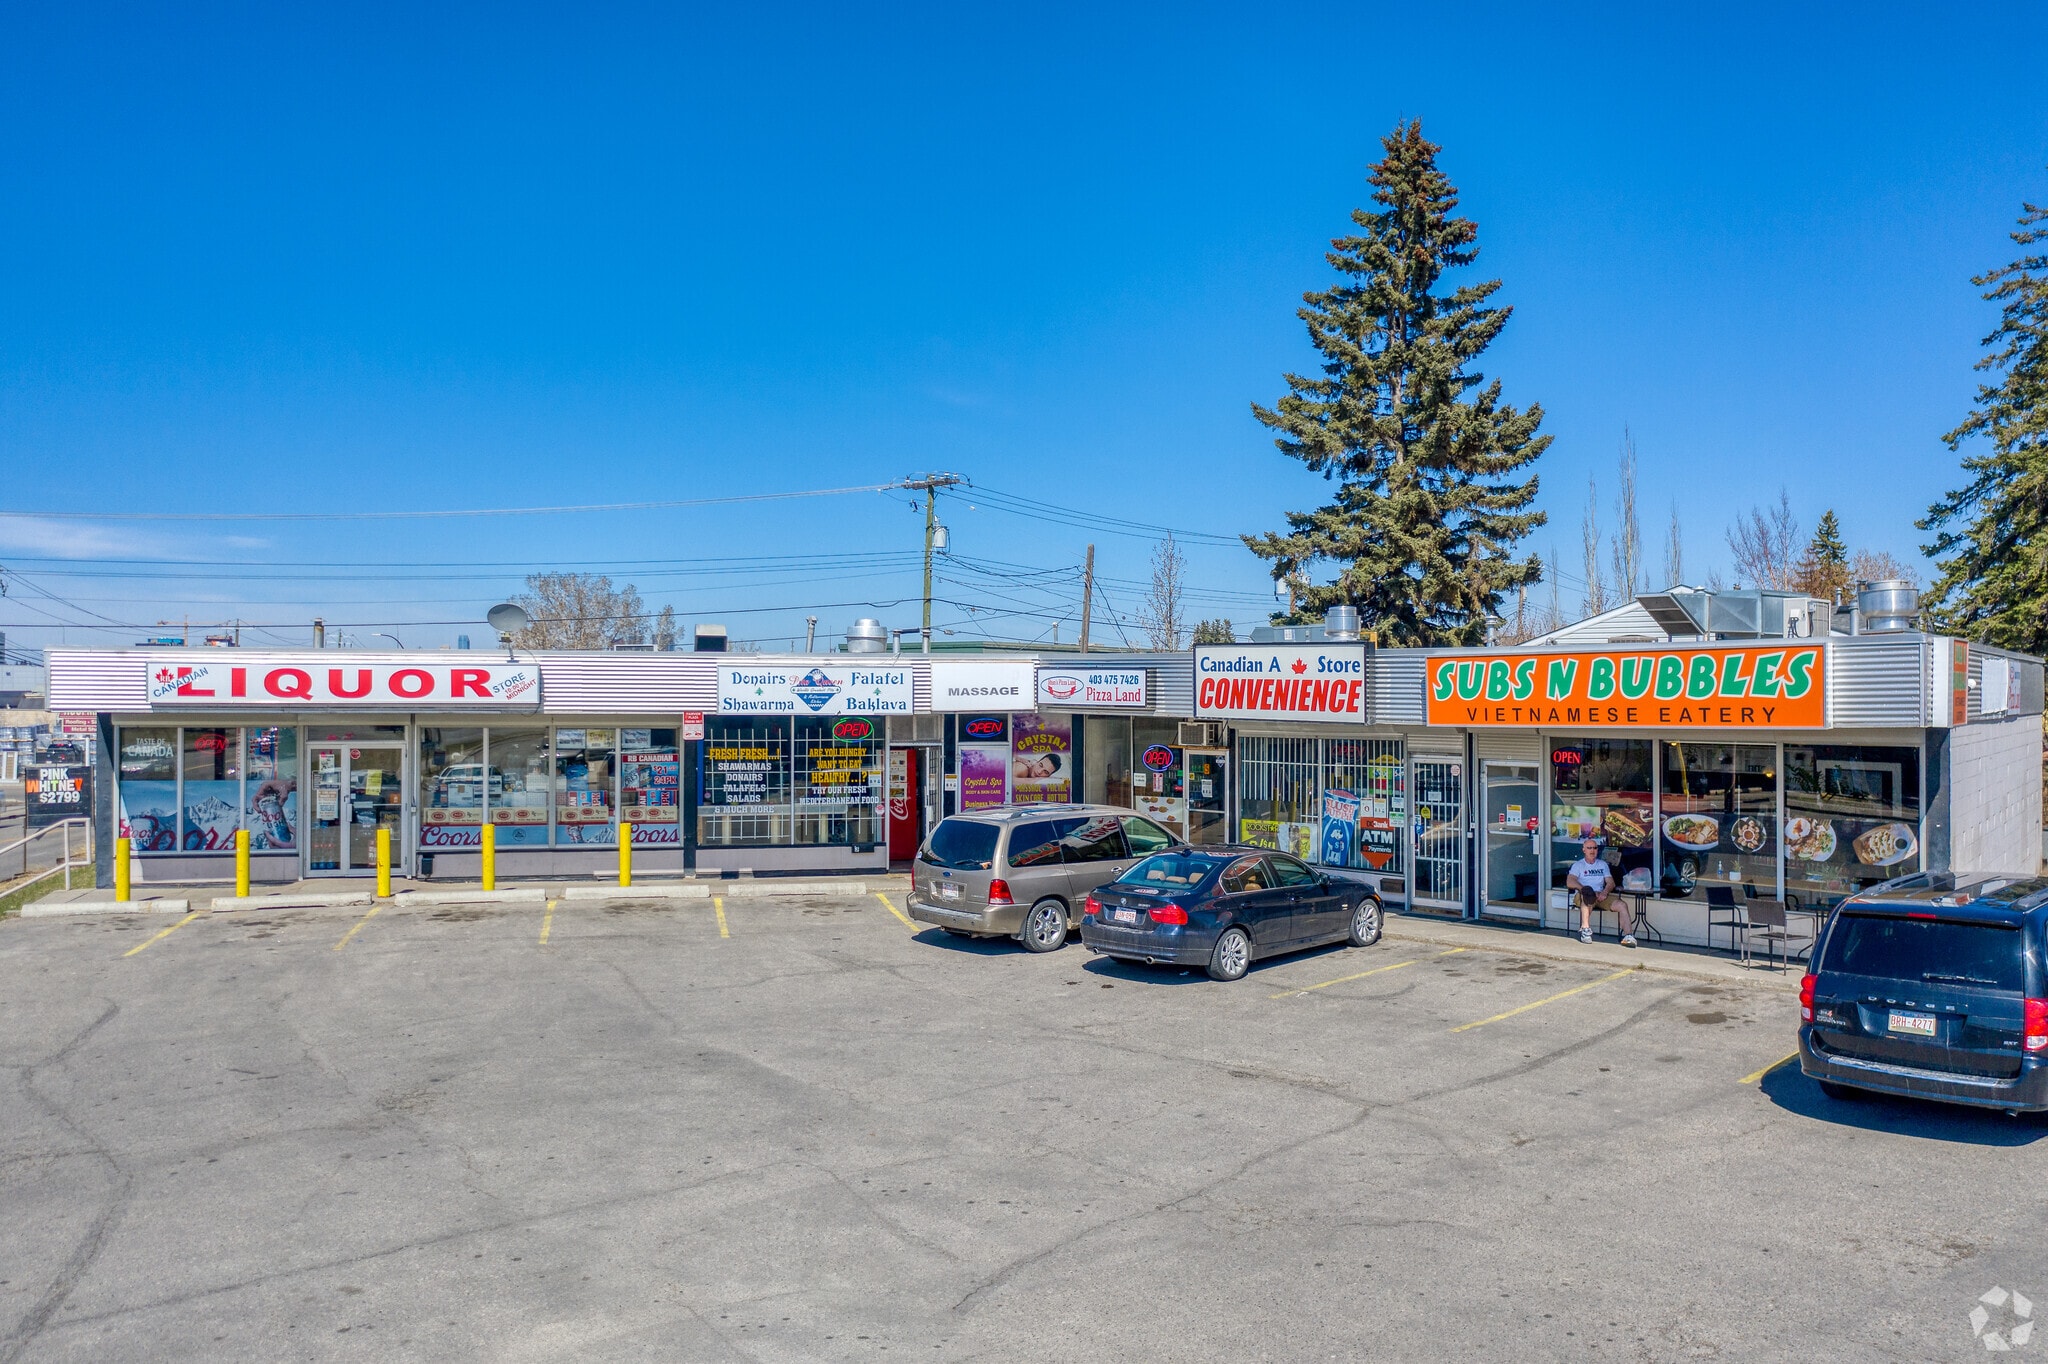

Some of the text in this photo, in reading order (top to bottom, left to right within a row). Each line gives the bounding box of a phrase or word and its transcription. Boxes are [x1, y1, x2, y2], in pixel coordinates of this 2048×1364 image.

[1200, 655, 1361, 673] Canadian A Store
[153, 667, 209, 697] CANADIAN
[731, 671, 904, 687] Donairs Falafel
[1088, 674, 1139, 685] 403 475 7426
[1432, 650, 1818, 702] SUBS N BUBBLES
[177, 666, 494, 701] LIQUOR
[492, 672, 526, 694] STORE
[505, 679, 537, 700] MIDNIGHT
[948, 686, 1019, 696] MASSAGE
[1085, 687, 1113, 702] Pizza
[1115, 688, 1141, 702] Land
[1199, 677, 1363, 713] CONVENIENCE
[722, 697, 907, 712] Shawarma Baklava
[1467, 706, 1776, 722] VIETNAMESE EATERY
[833, 723, 870, 736] OPEN
[967, 721, 1003, 733] OPEN
[136, 737, 156, 745] TASTE
[194, 738, 227, 750] OPEN
[1016, 733, 1068, 751] CRYSTAL
[127, 745, 174, 758] CANADA
[709, 748, 738, 760] FRESH
[809, 748, 867, 757] ARE YOU HUNGRY
[1032, 745, 1053, 753] SPA
[627, 754, 674, 762] RB CANADIAN
[1144, 751, 1171, 765] OPEN
[1553, 750, 1581, 764] OPEN
[718, 762, 772, 771] SHAWARMAS
[817, 760, 863, 769] WANT TO EAT
[40, 768, 69, 780] PINK
[653, 776, 678, 785] 24PK
[727, 773, 764, 782] DONAIRS
[26, 778, 84, 793] WHITNEY
[723, 784, 767, 792] FALAFELS
[964, 777, 1003, 788] Crystal Spa
[811, 785, 867, 794] TRY OUR FRESH
[40, 791, 80, 804] $2799
[727, 794, 761, 803] SALADS
[800, 796, 880, 806] MEDITERRANEAN FOOD
[1015, 793, 1068, 802] SKIN CARE HOT TUB
[714, 805, 775, 814] & MUCH MORE
[1326, 797, 1356, 813] SLUSH
[420, 825, 483, 846] Coors
[1361, 830, 1393, 845] ATM
[1890, 1015, 1933, 1030] BRH-4277
